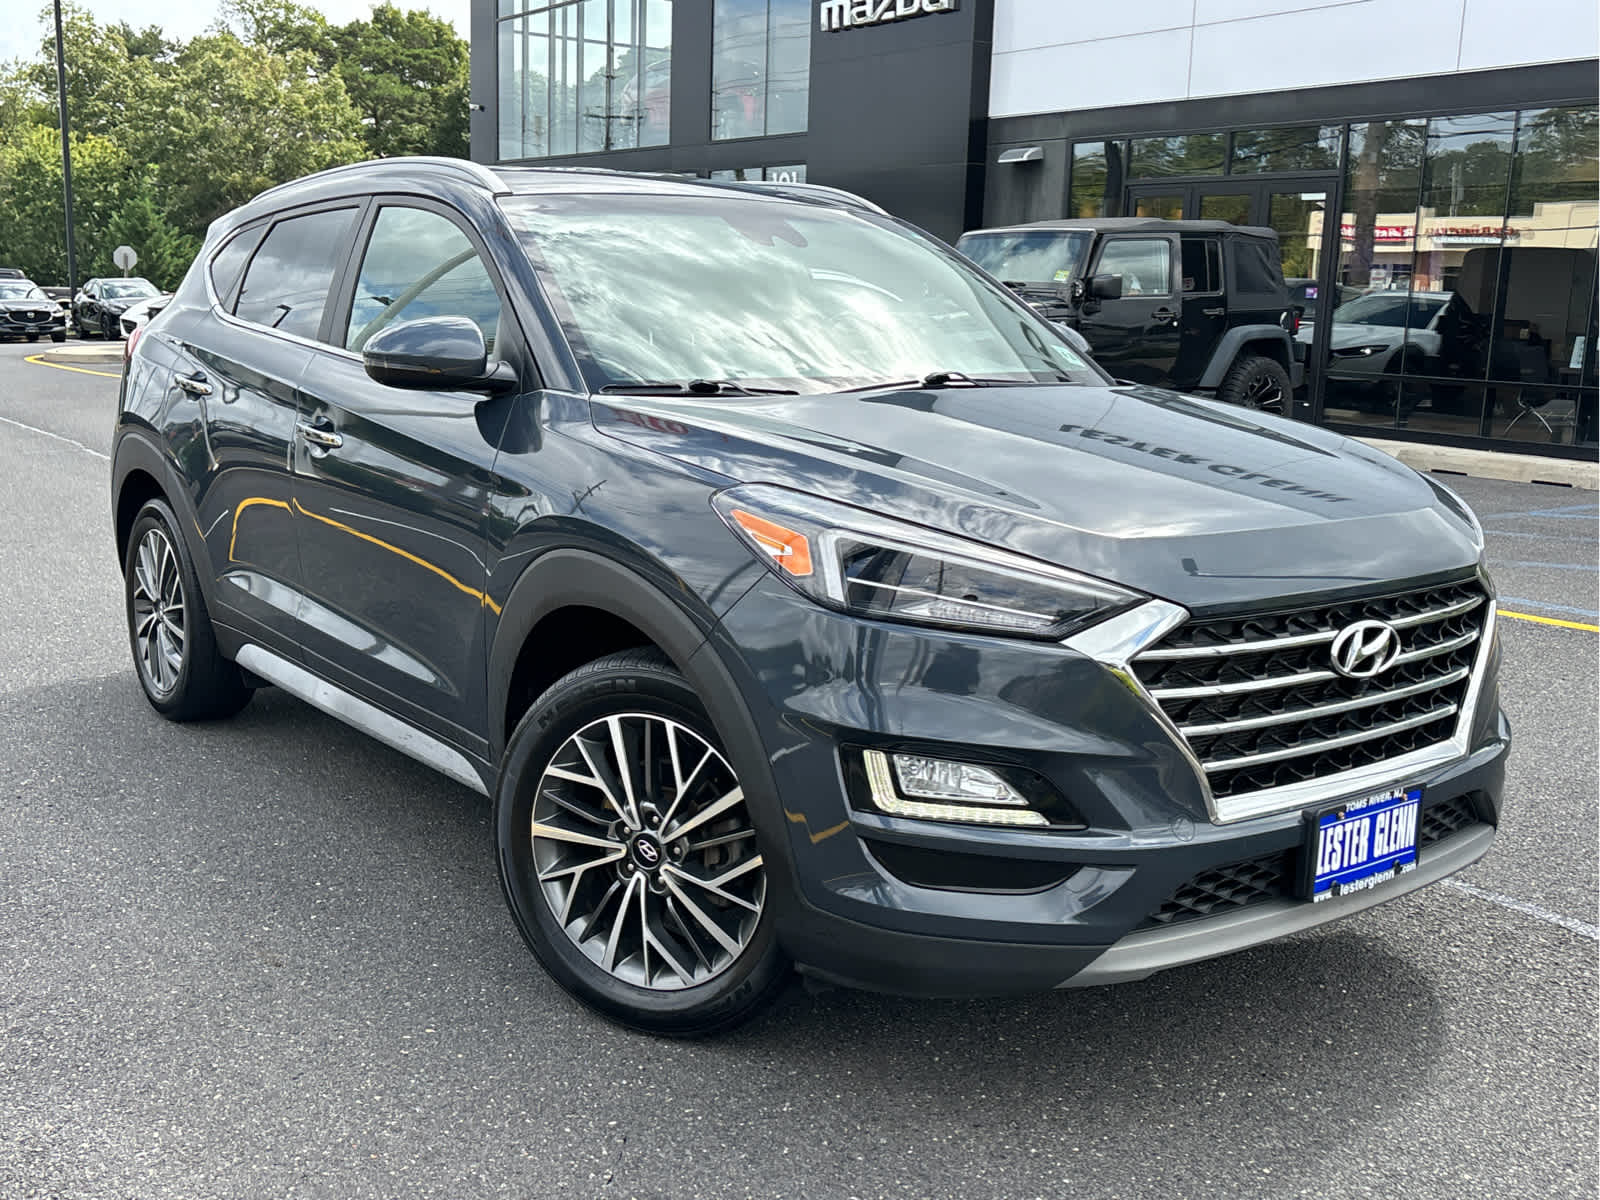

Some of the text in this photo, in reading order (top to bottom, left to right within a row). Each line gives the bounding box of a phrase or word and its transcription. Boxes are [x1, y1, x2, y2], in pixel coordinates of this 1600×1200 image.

[1346, 800, 1367, 813] TOMS
[1393, 787, 1404, 799] NJ
[1316, 803, 1418, 876] LESTER GLENN
[1340, 871, 1394, 896] lesterglenn
